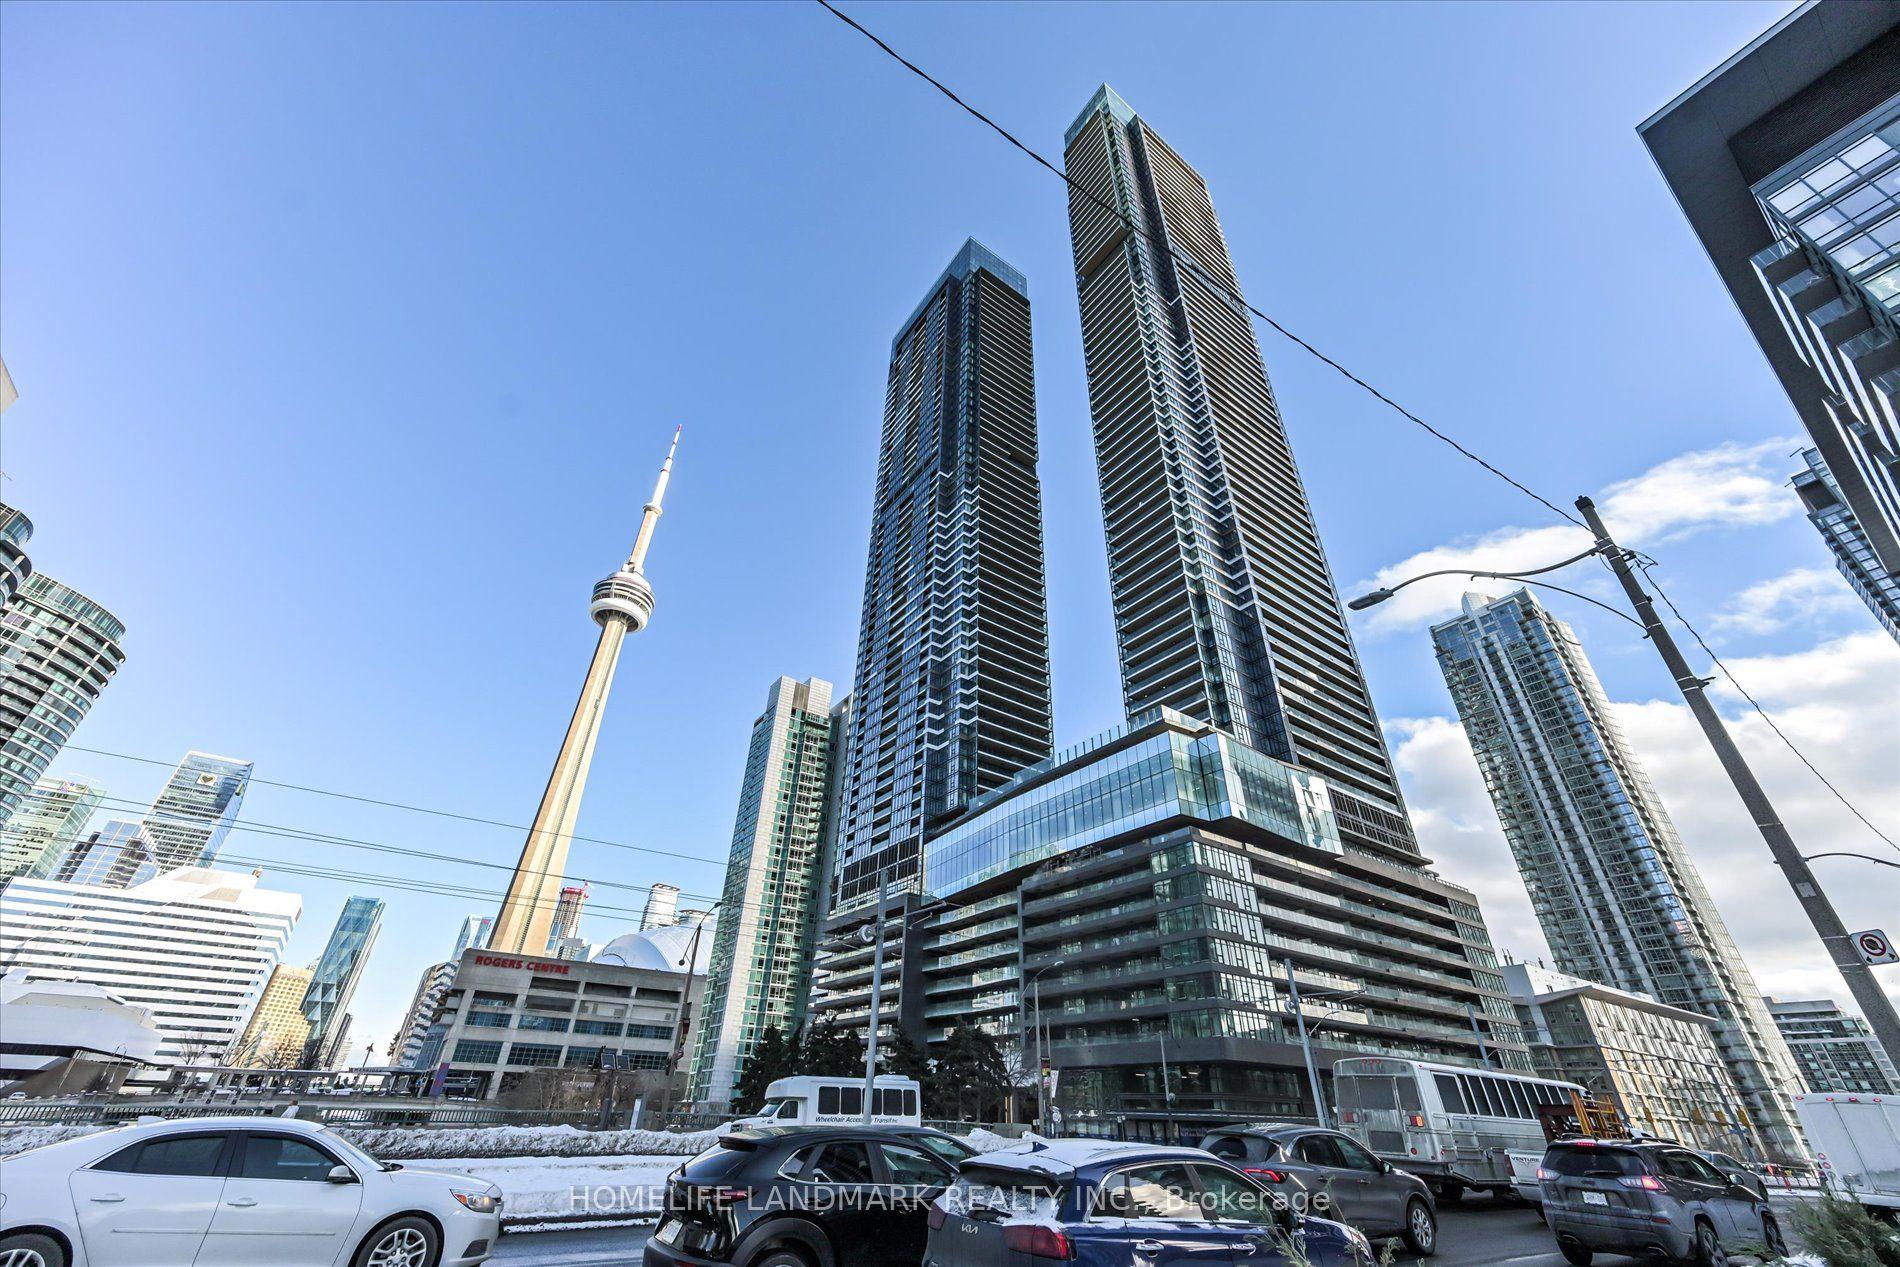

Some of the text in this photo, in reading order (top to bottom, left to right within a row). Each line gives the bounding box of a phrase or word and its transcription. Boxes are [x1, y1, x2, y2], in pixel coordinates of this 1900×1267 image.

[474, 955, 570, 975] ROGERS CENTRE
[961, 1223, 979, 1235] KIA
